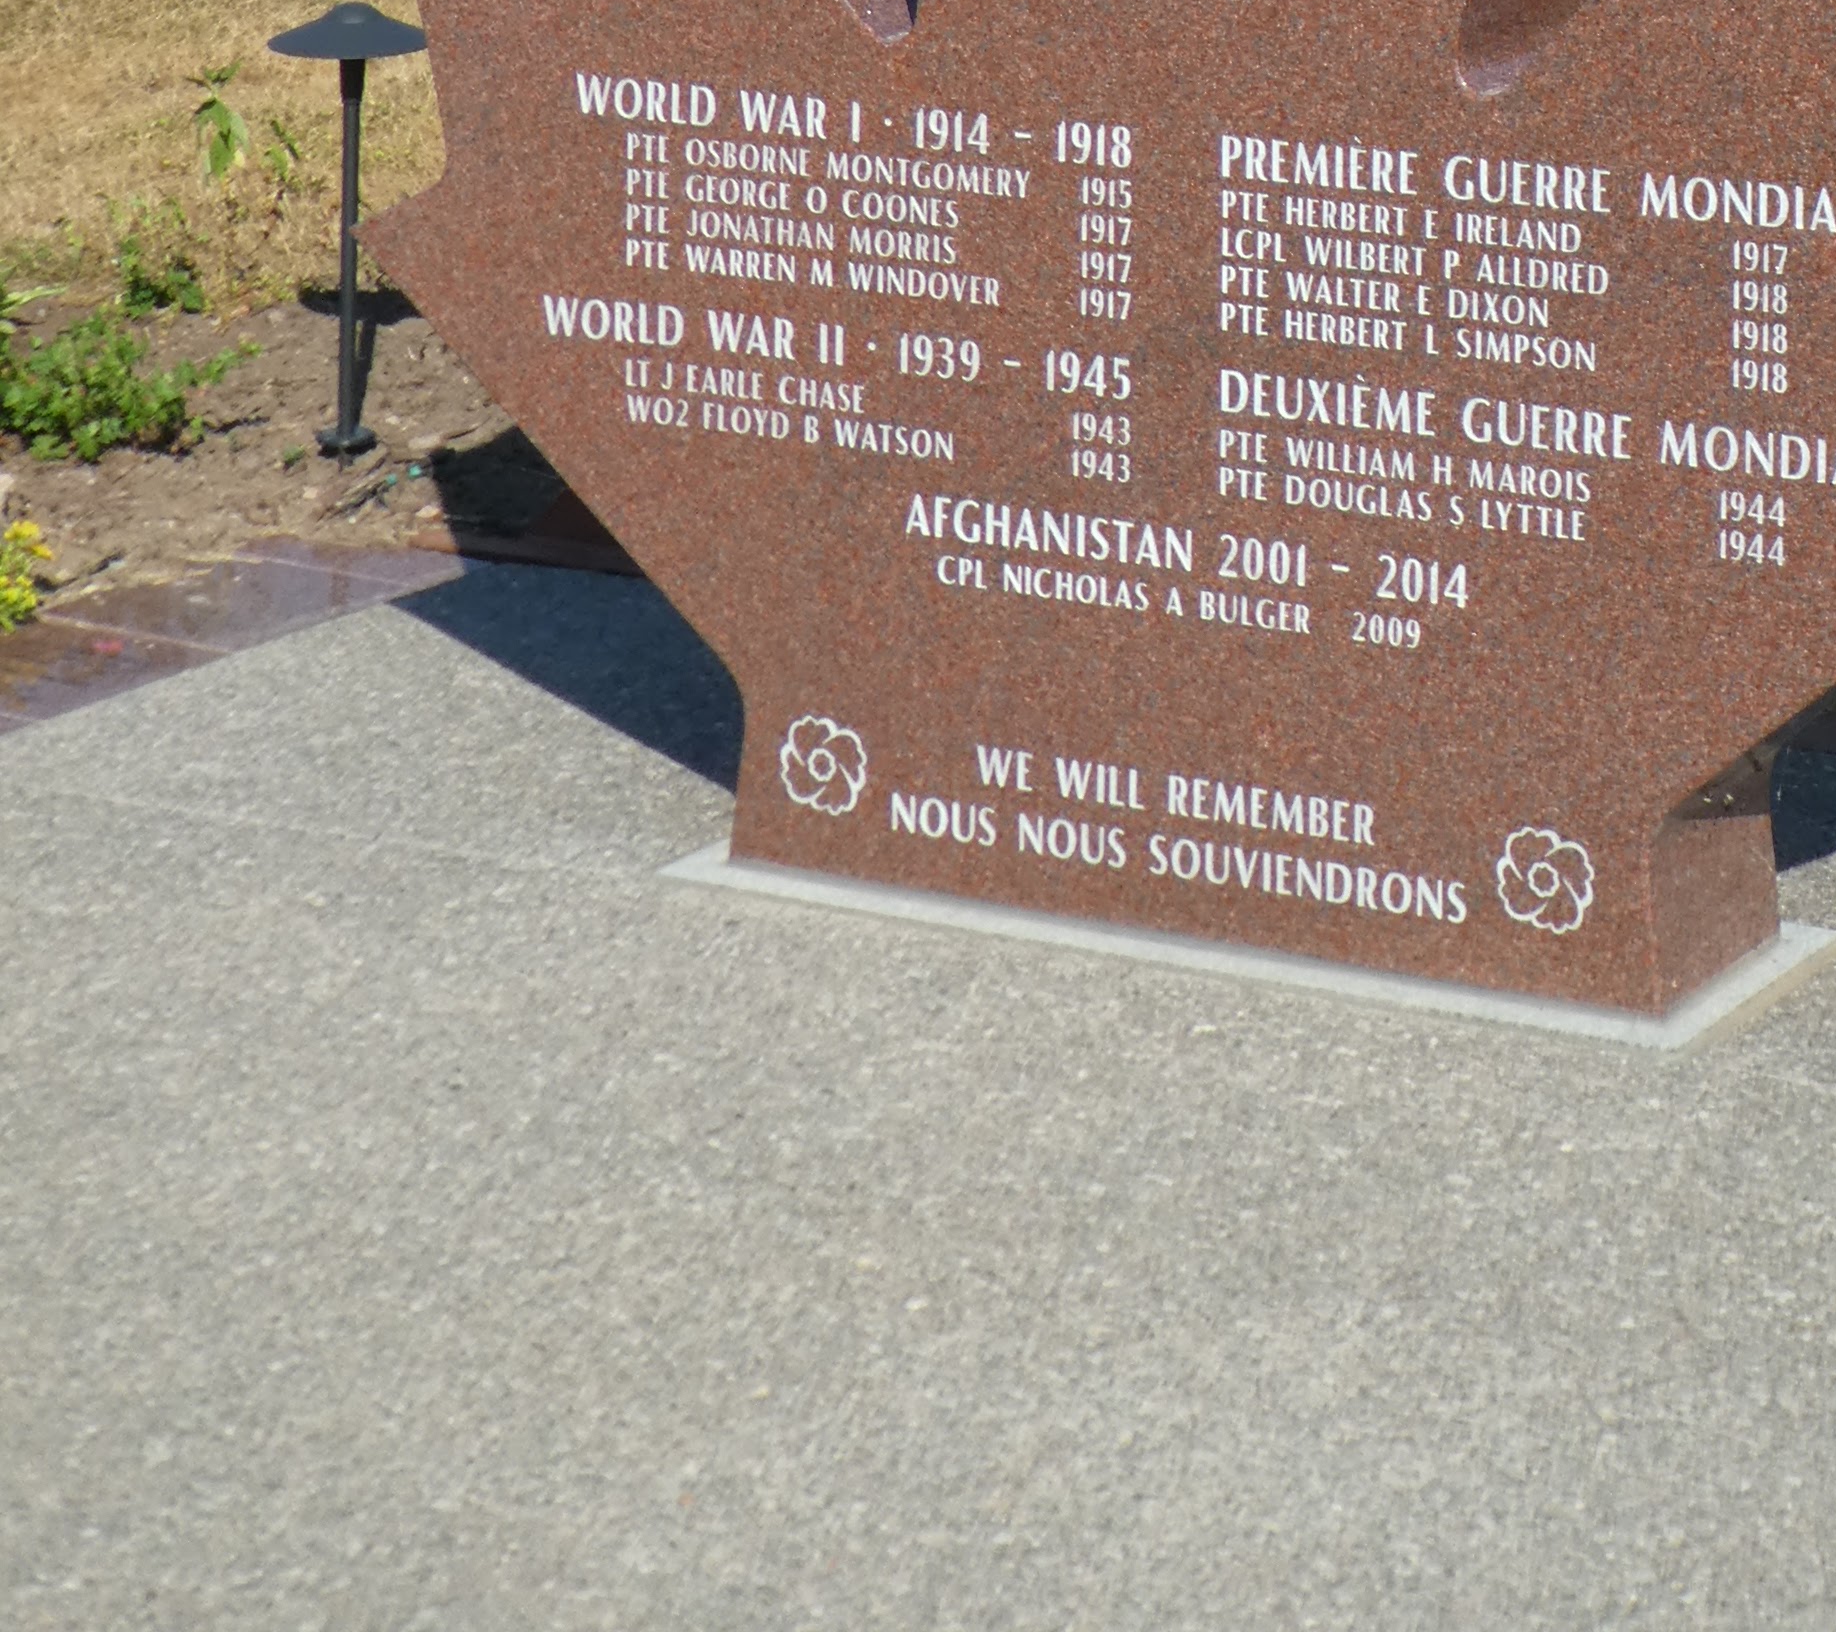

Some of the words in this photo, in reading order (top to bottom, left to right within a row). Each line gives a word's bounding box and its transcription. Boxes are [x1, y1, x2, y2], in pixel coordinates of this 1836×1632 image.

[575, 71, 718, 127] WORLD
[739, 88, 828, 141] WAR
[850, 100, 862, 144] I
[914, 106, 991, 156] 1914
[1056, 119, 1133, 169] 1918
[625, 131, 671, 164] PTE
[684, 137, 812, 178] OSBORNE
[825, 150, 1032, 200] MONTGOMERY
[1080, 175, 1133, 210] 1915
[625, 167, 671, 200] PTE
[683, 173, 792, 212] GEORGE
[804, 184, 829, 215] O
[841, 188, 960, 229] COONES
[1079, 212, 1133, 247] 1917
[1220, 133, 1419, 196] PREMIÈRE
[1442, 154, 1612, 214] GUERRE
[625, 201, 671, 235] PTE
[685, 208, 835, 252] JONATHAN
[848, 224, 958, 265] MORRIS
[1080, 249, 1133, 284] 1917
[1220, 188, 1270, 224] PTE
[1284, 194, 1409, 237] HERBERT
[1423, 208, 1440, 240] E
[1455, 211, 1583, 254] IRELAND
[1732, 238, 1789, 276] 1917
[1220, 225, 1288, 263] LCPL
[1303, 234, 1428, 277] WILBERT
[1443, 248, 1461, 281] P
[1475, 252, 1610, 296] ALLDRED
[1731, 278, 1789, 316] 1918
[625, 237, 671, 271] PTE
[684, 242, 797, 284] WARREN
[809, 257, 835, 288] M
[847, 260, 1001, 308] WINDOVER
[1079, 286, 1133, 321] 1917
[1219, 263, 1270, 299] PTE
[1285, 270, 1402, 314] WALTER
[1416, 283, 1433, 317] E
[1447, 287, 1550, 329] DIXON
[1731, 318, 1789, 355] 1918
[542, 293, 685, 347] WORLD
[706, 308, 796, 362] WAR
[818, 321, 845, 367] II
[899, 331, 982, 383] 1939
[1045, 348, 1132, 401] 1945
[1219, 300, 1270, 337] PTE
[1284, 308, 1409, 352] HERBERT
[1425, 322, 1440, 356] L
[1455, 327, 1597, 373] SIMPSON
[1731, 357, 1789, 395] 1918
[624, 357, 652, 389] LT
[660, 361, 674, 391] J
[685, 363, 765, 402] EARLE
[777, 374, 866, 415] CHASE
[1071, 411, 1132, 447] 1943
[625, 393, 690, 428] WO2
[702, 400, 791, 440] FLOYD
[803, 414, 821, 445] B
[833, 417, 955, 462] WATSON
[1070, 447, 1132, 484] 1943
[1219, 368, 1437, 438] DEUXIÈME
[1460, 396, 1633, 460] GUERRE
[1218, 428, 1269, 465] PTE
[1284, 435, 1416, 483] WILLIAM
[1432, 453, 1453, 487] H
[1468, 457, 1592, 504] MAROIS
[1719, 489, 1788, 528] 1944
[1218, 465, 1269, 502] PTE
[1284, 473, 1433, 523] DOUGLAS
[1448, 494, 1465, 527] S
[1480, 497, 1586, 542] LYTTLE
[1718, 528, 1787, 568] 1944
[904, 492, 1194, 573] AFGHANISTAN
[1217, 532, 1307, 588] 2001
[1375, 553, 1470, 610] 2014
[936, 554, 989, 591] CPL
[1002, 562, 1151, 612] NICHOLAS
[1165, 585, 1185, 618] A
[1198, 589, 1311, 635] BULGER
[1350, 610, 1422, 650] 2009
[975, 744, 1034, 793] WE
[1054, 756, 1146, 811] WILL
[1166, 773, 1376, 847] REMEMBER
[890, 791, 997, 847] NOUS
[1017, 811, 1128, 869] NOUS
[1148, 833, 1468, 925] SOUVIENDRONS
